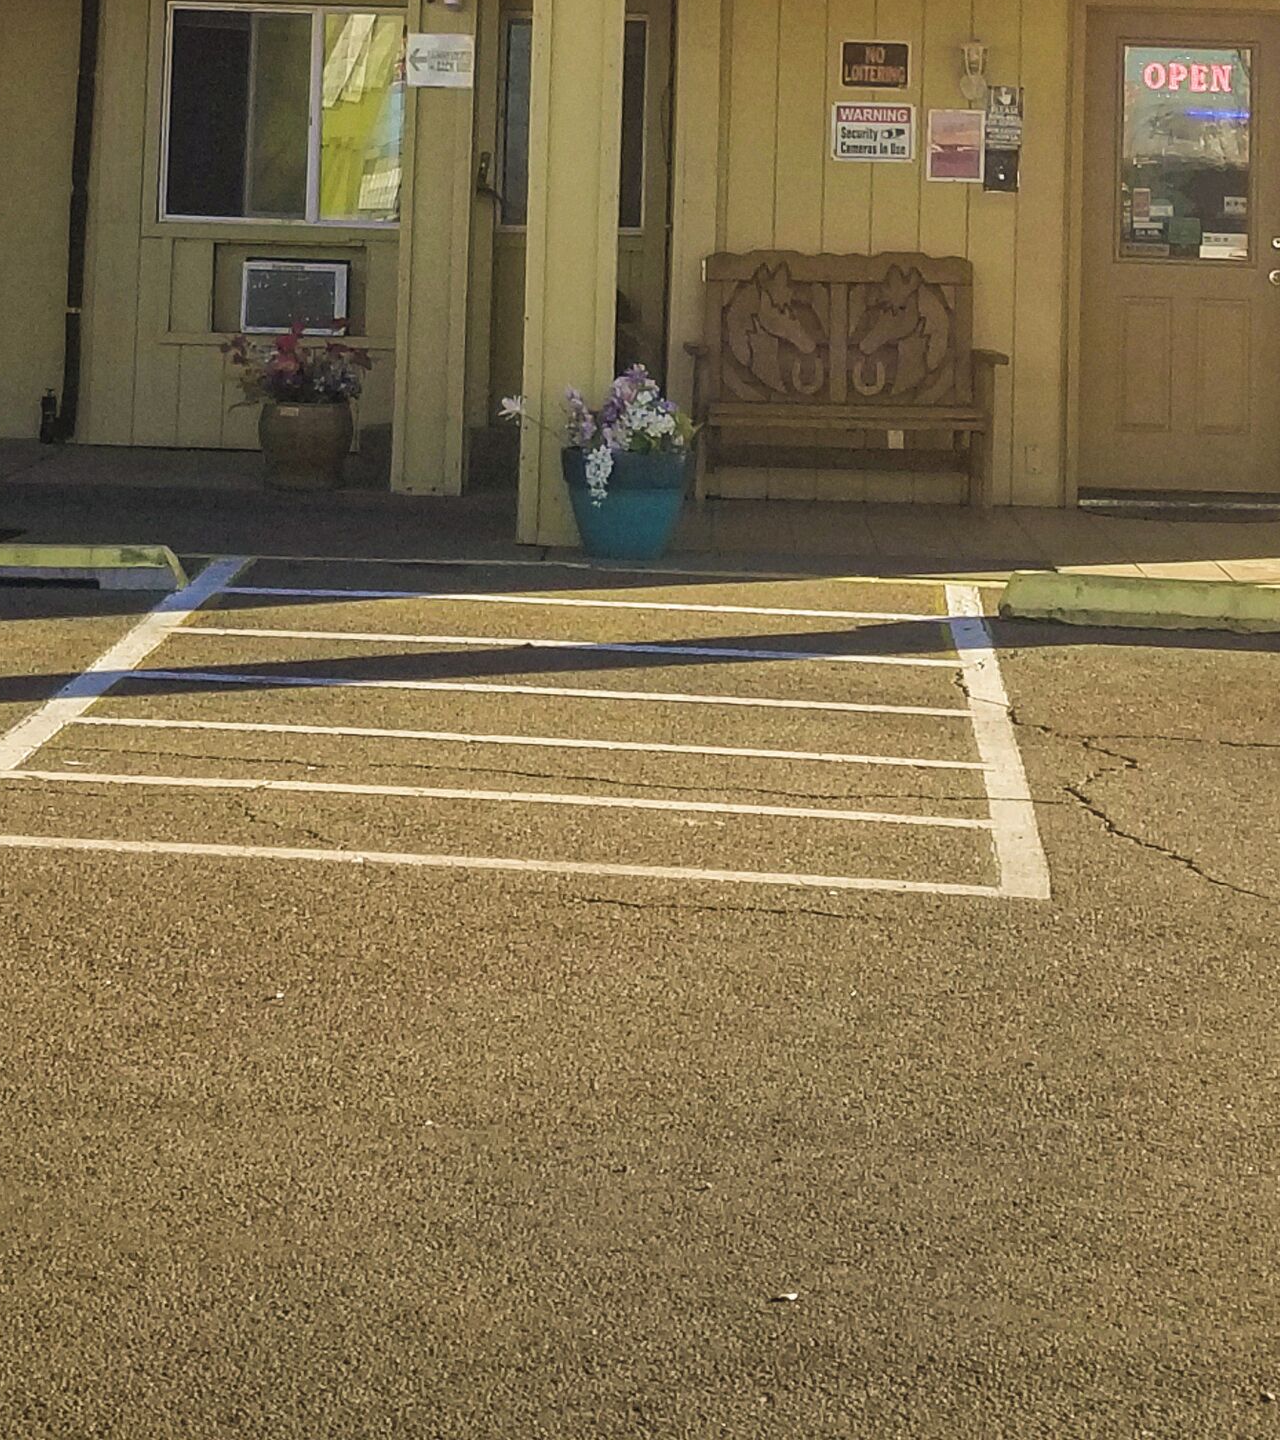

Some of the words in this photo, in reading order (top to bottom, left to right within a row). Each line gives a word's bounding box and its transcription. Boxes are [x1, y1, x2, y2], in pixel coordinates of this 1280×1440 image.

[865, 46, 886, 64] NO
[845, 63, 906, 83] LOITERING
[1143, 61, 1233, 92] OPEN
[839, 107, 909, 122] WARNING
[841, 126, 878, 142] Security
[841, 141, 877, 155] Cameras
[879, 142, 889, 155] In
[890, 142, 906, 155] Use
